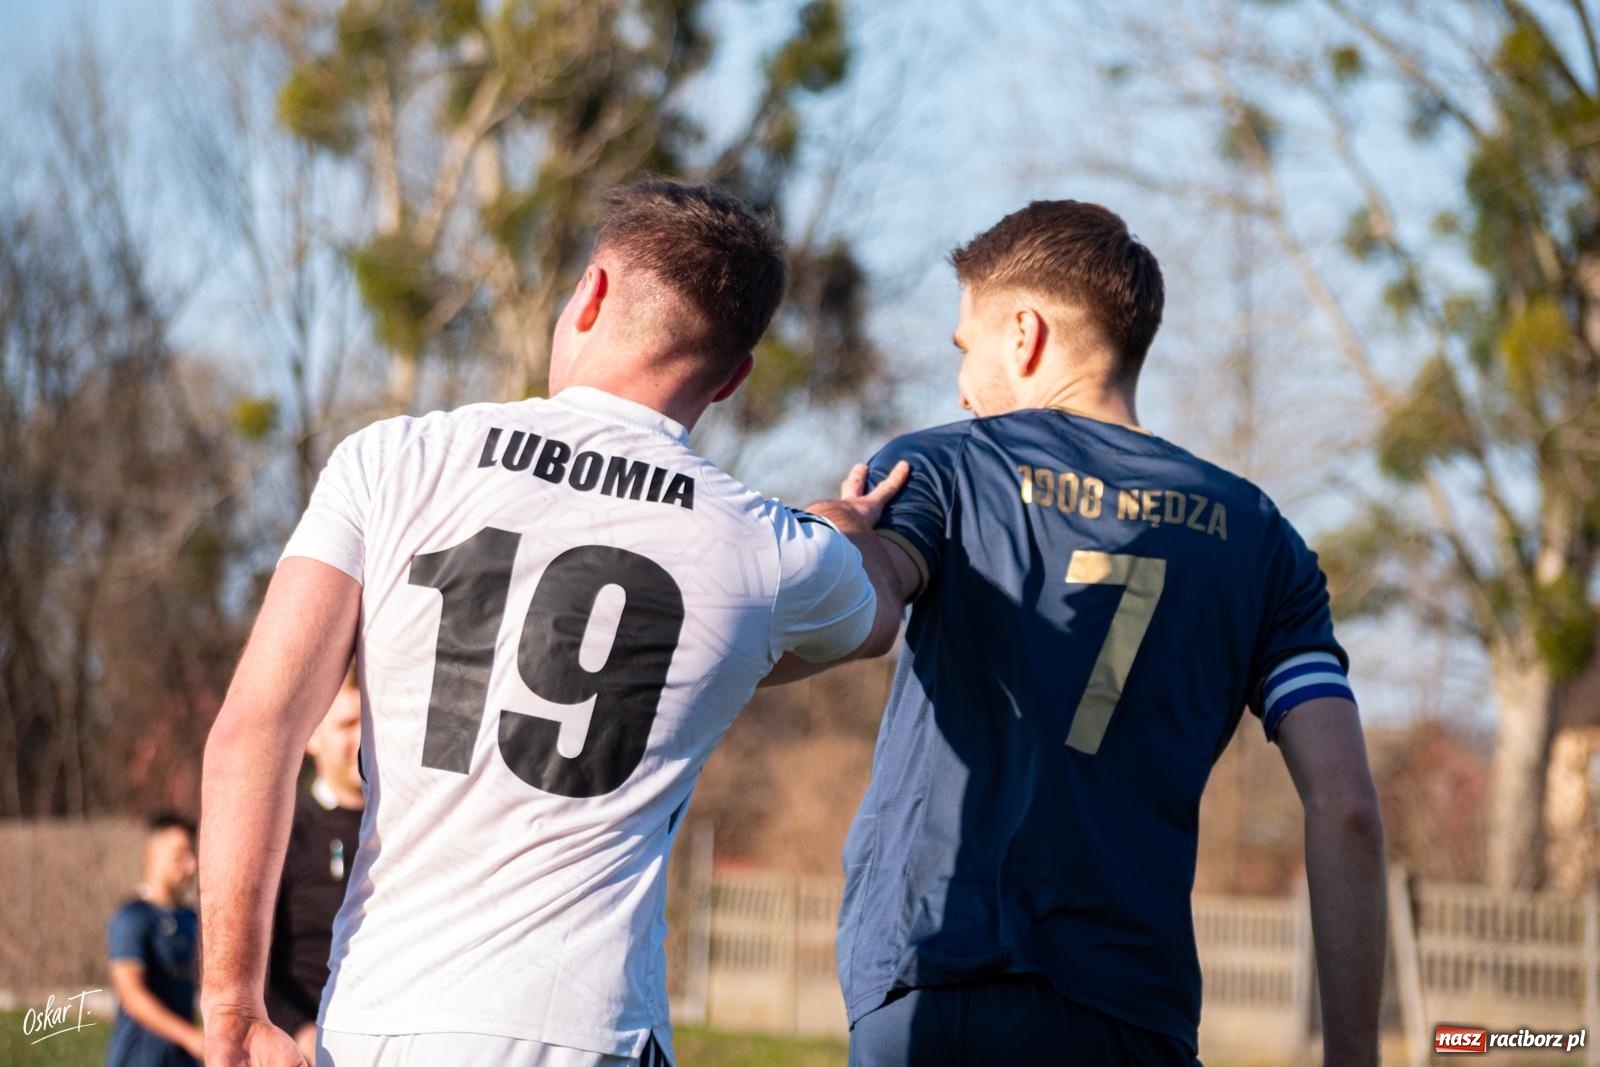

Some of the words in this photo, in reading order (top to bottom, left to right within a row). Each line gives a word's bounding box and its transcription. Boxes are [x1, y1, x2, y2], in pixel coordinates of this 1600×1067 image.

[478, 427, 695, 510] LUBOMIA
[1018, 465, 1104, 519] 1908
[1117, 489, 1228, 541] NĘDZA
[408, 526, 685, 798] 19
[1065, 550, 1167, 755] 7
